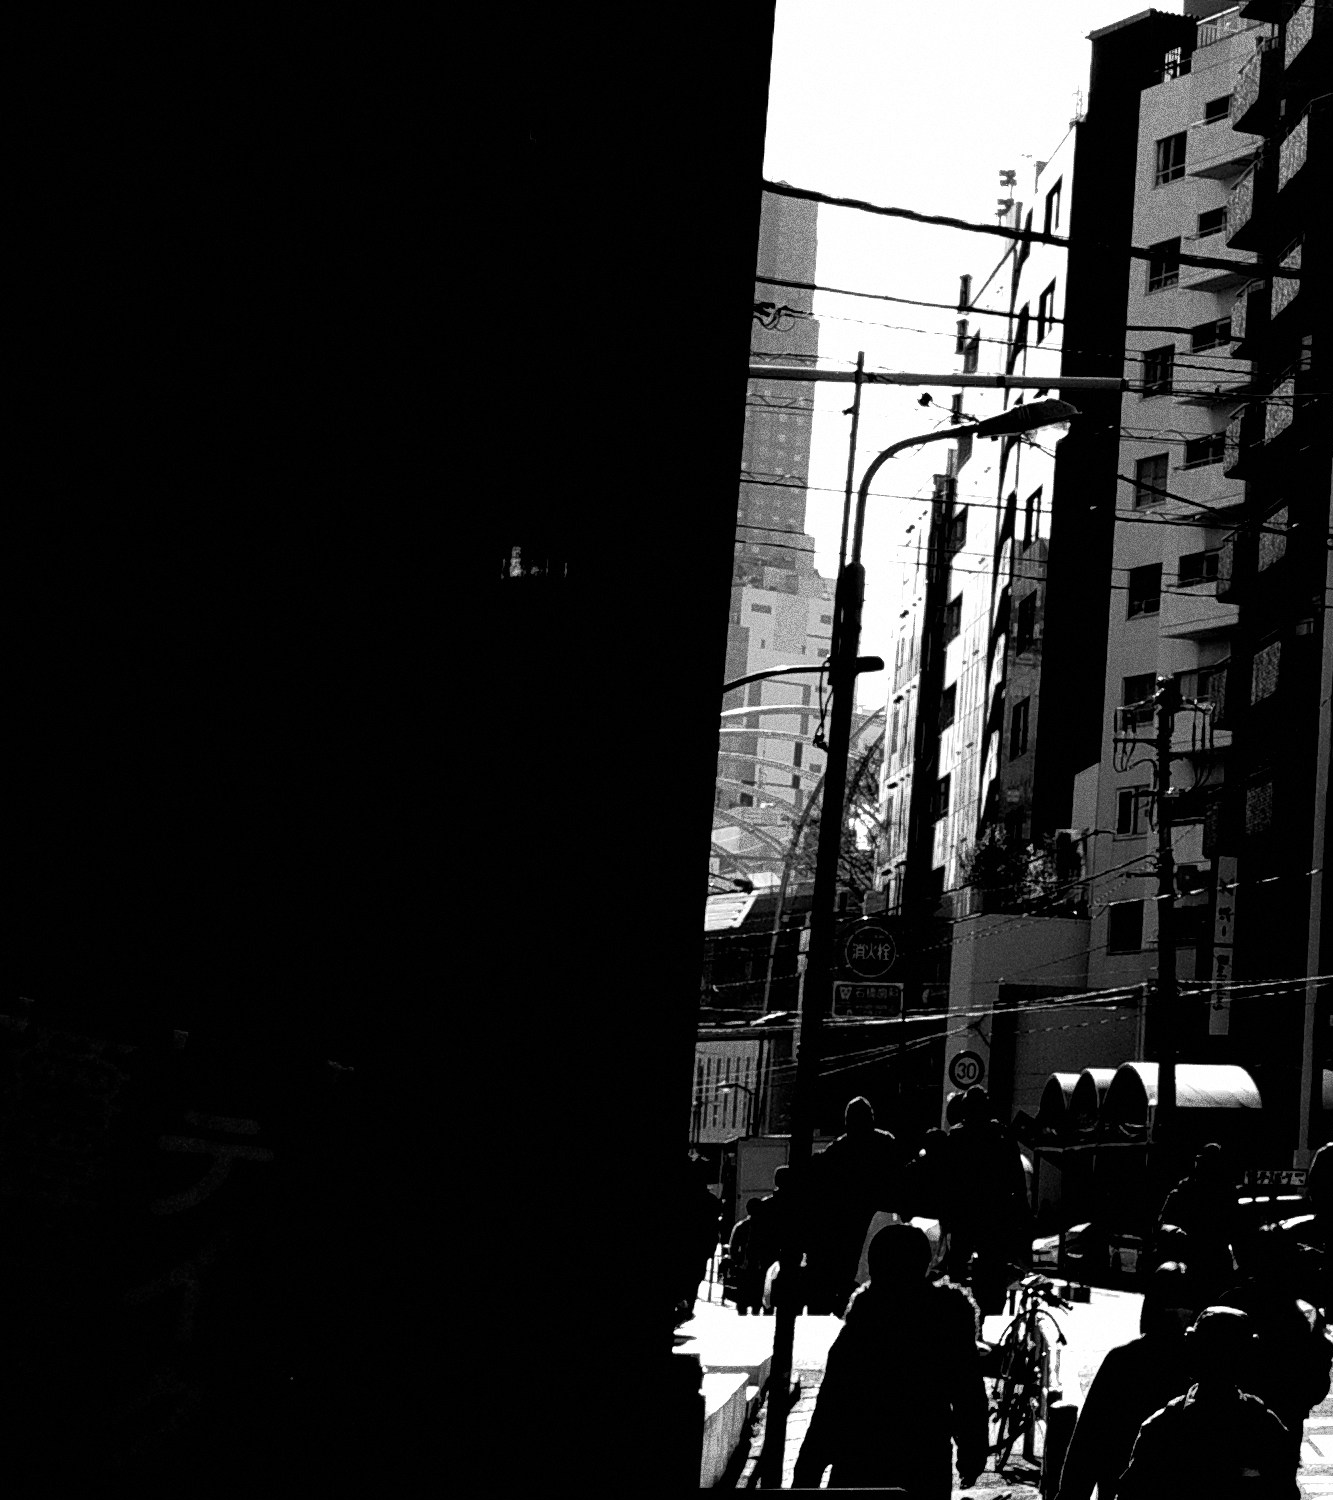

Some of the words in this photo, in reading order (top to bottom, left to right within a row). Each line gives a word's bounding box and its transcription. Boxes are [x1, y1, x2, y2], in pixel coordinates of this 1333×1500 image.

[852, 943, 891, 961] 消火栓
[956, 1062, 977, 1080] 30
